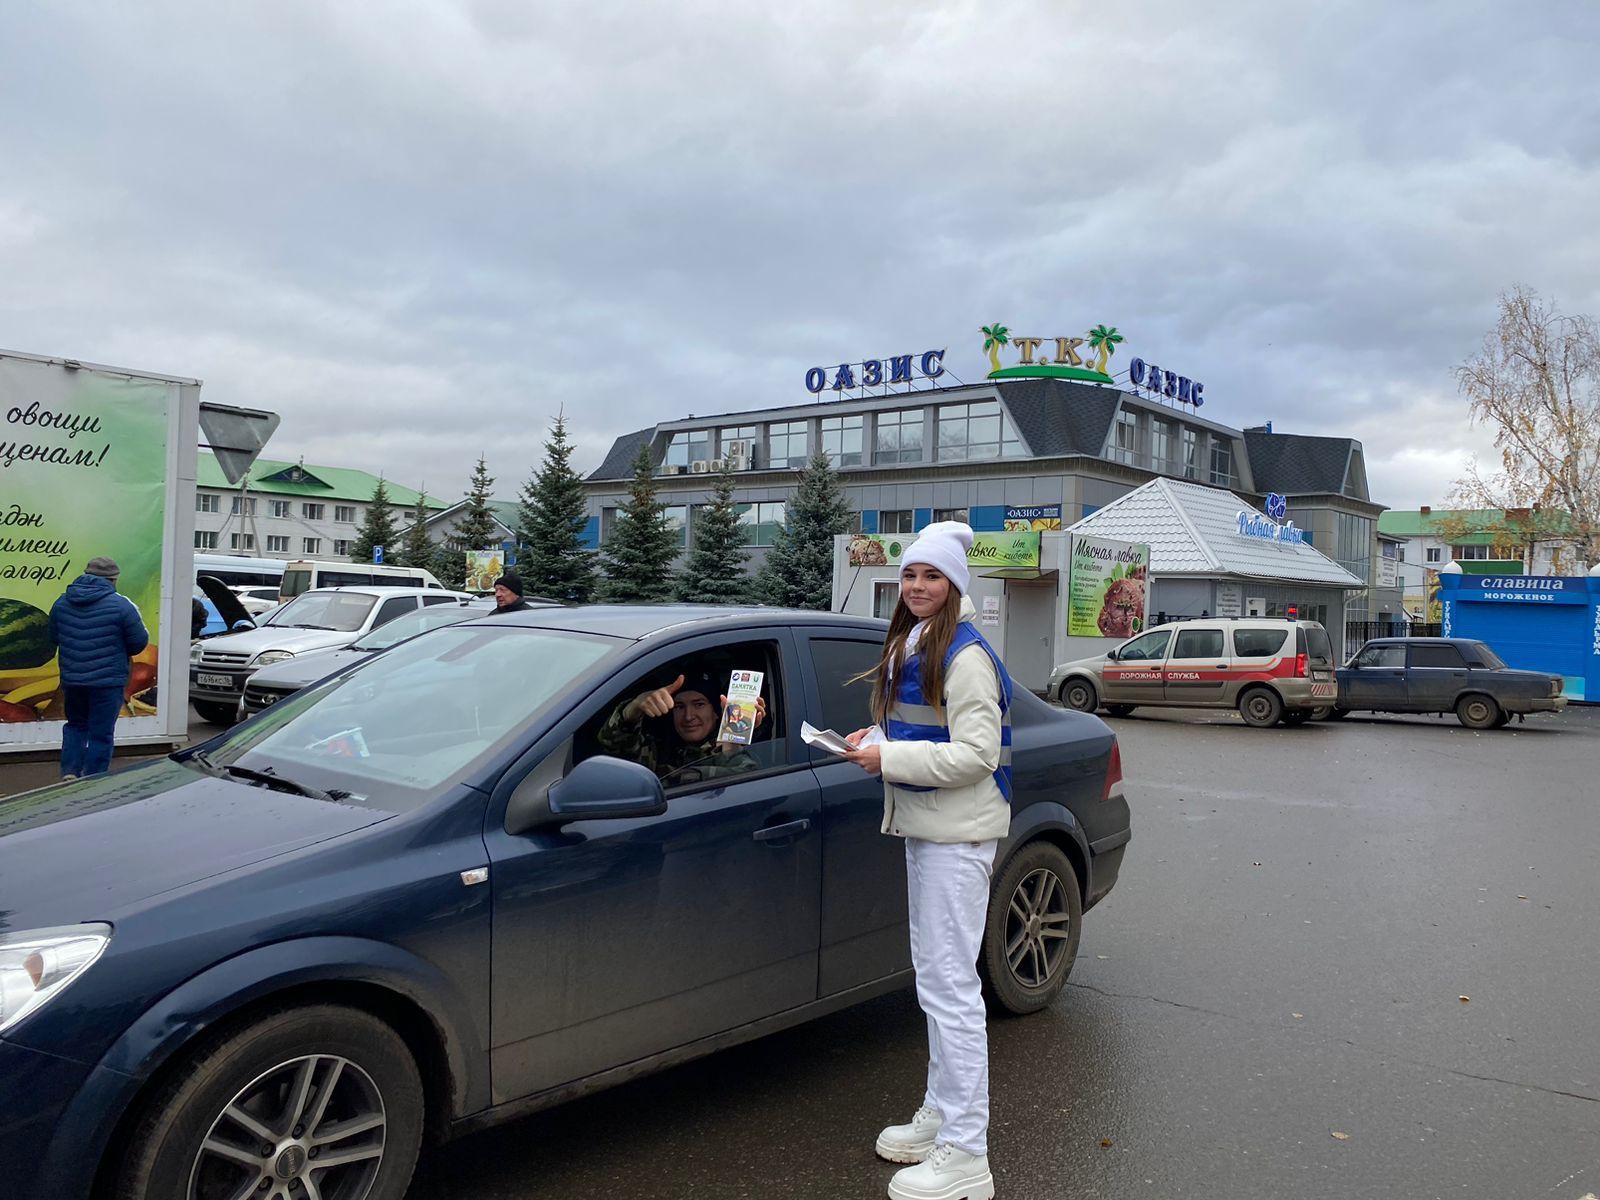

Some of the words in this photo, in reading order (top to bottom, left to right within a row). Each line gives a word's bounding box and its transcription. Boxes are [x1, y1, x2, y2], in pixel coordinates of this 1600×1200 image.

[805, 350, 946, 393] ОАЗИС
[1130, 357, 1205, 408] ОАЗИС
[6, 401, 102, 439] овощи
[0, 441, 110, 468] ценам!
[1236, 511, 1275, 540] Рыбная
[966, 541, 997, 558] авка
[1074, 537, 1113, 561] Мясная
[1114, 545, 1142, 564] лавка
[1484, 592, 1554, 601] МОРОЖЕНОЕ
[1120, 672, 1162, 680] ДОРОЖНАЯ
[1167, 672, 1200, 680] СЛУЖБА
